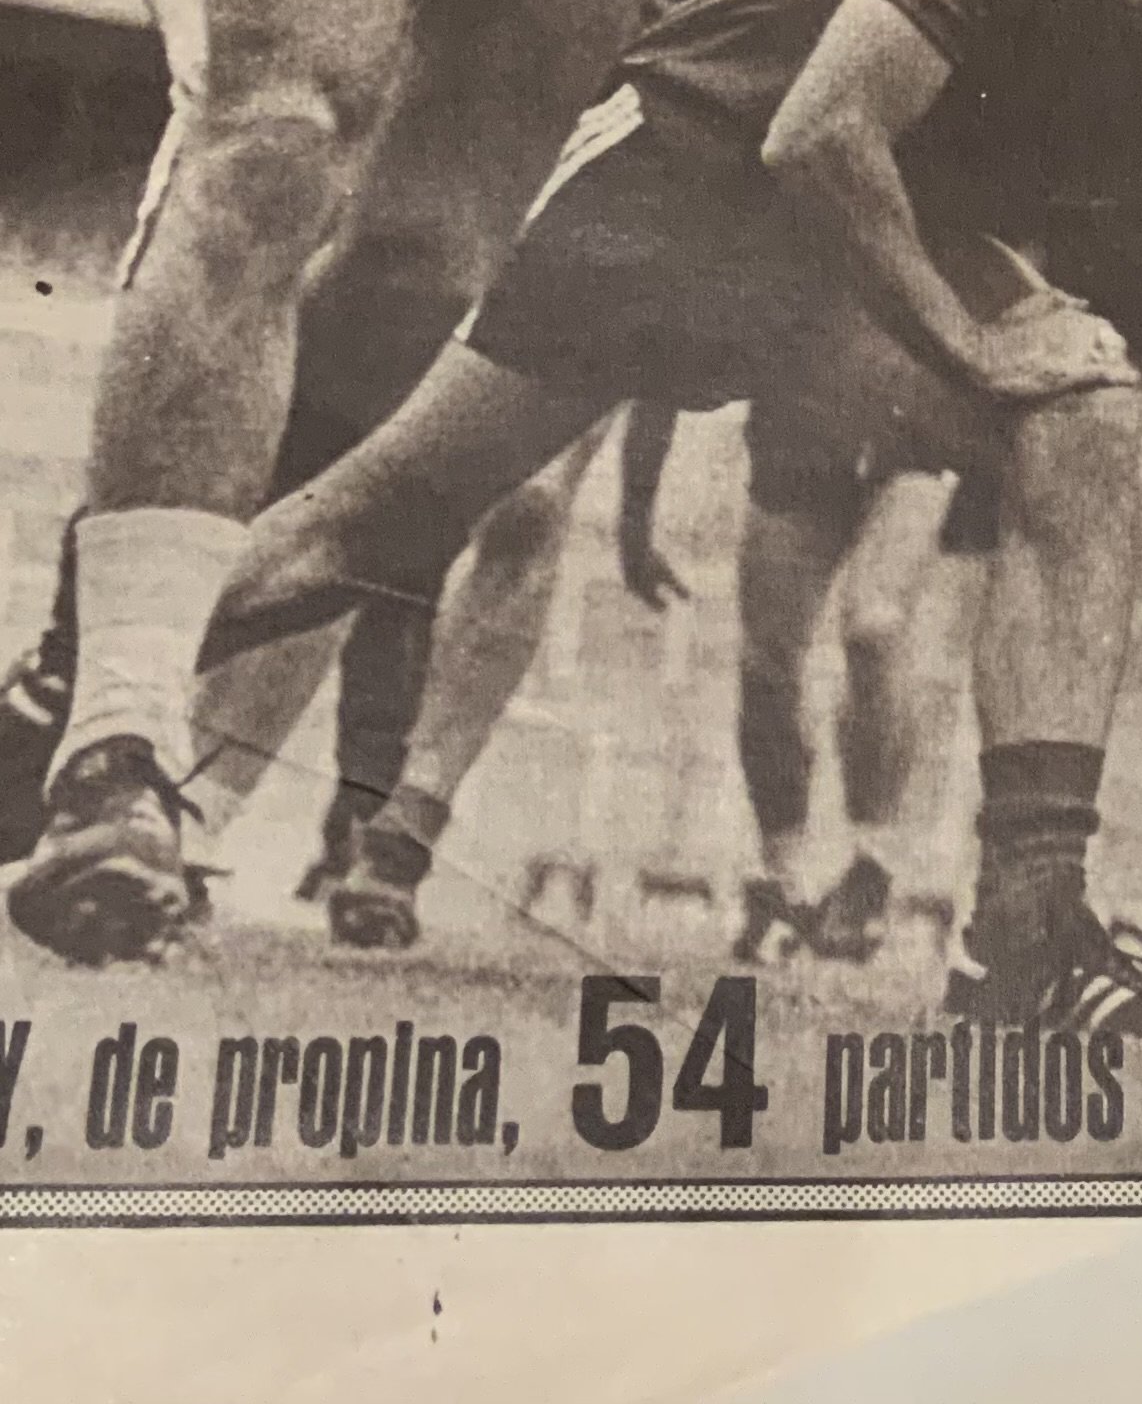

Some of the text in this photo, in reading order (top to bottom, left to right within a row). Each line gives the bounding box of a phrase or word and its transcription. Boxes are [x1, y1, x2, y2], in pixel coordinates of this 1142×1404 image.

[86, 1022, 180, 1150] de
[208, 1020, 520, 1159] propina,
[570, 975, 768, 1151] 54
[823, 1016, 1125, 1155] partidos
